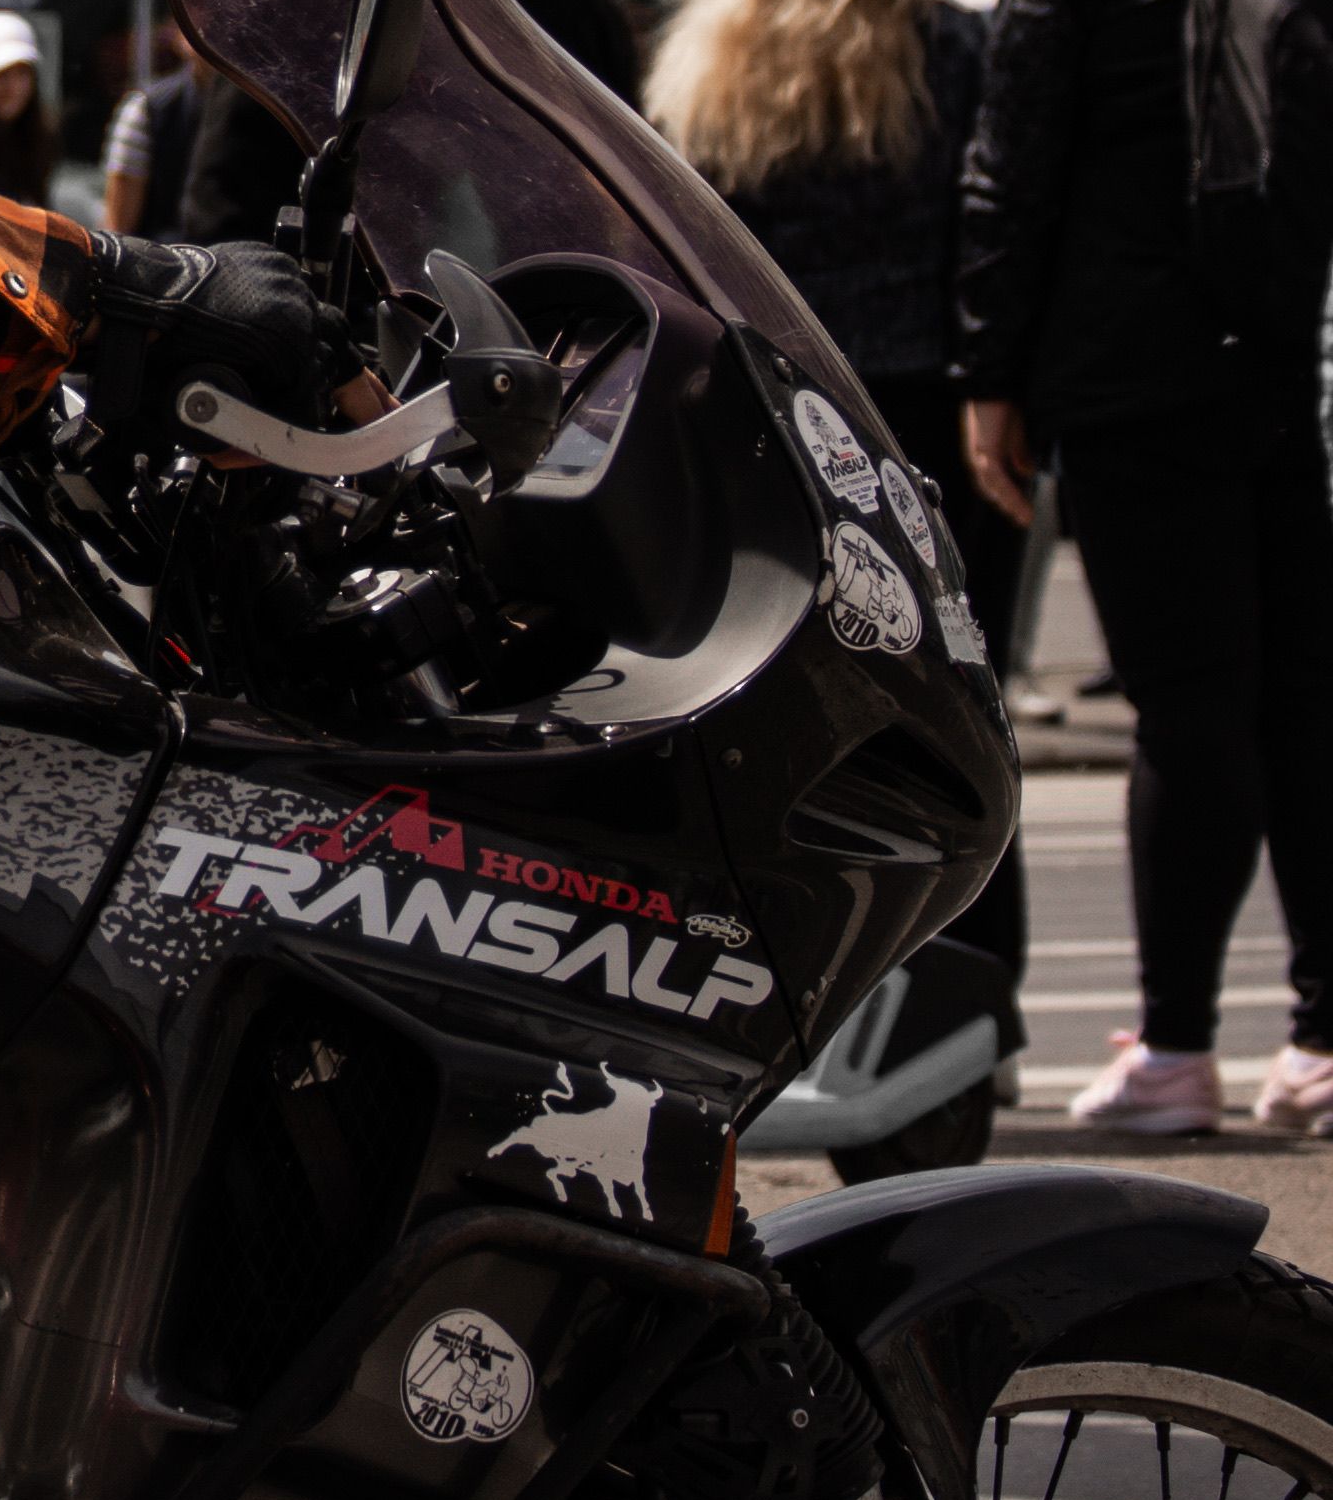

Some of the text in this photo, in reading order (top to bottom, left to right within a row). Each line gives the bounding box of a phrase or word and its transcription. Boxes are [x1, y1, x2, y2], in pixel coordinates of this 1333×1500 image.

[822, 455, 869, 481] TRANSALP
[836, 608, 880, 647] 2010
[475, 848, 679, 925] HONDA
[156, 825, 775, 1021] TRANSALP
[412, 1402, 467, 1438] 2010
